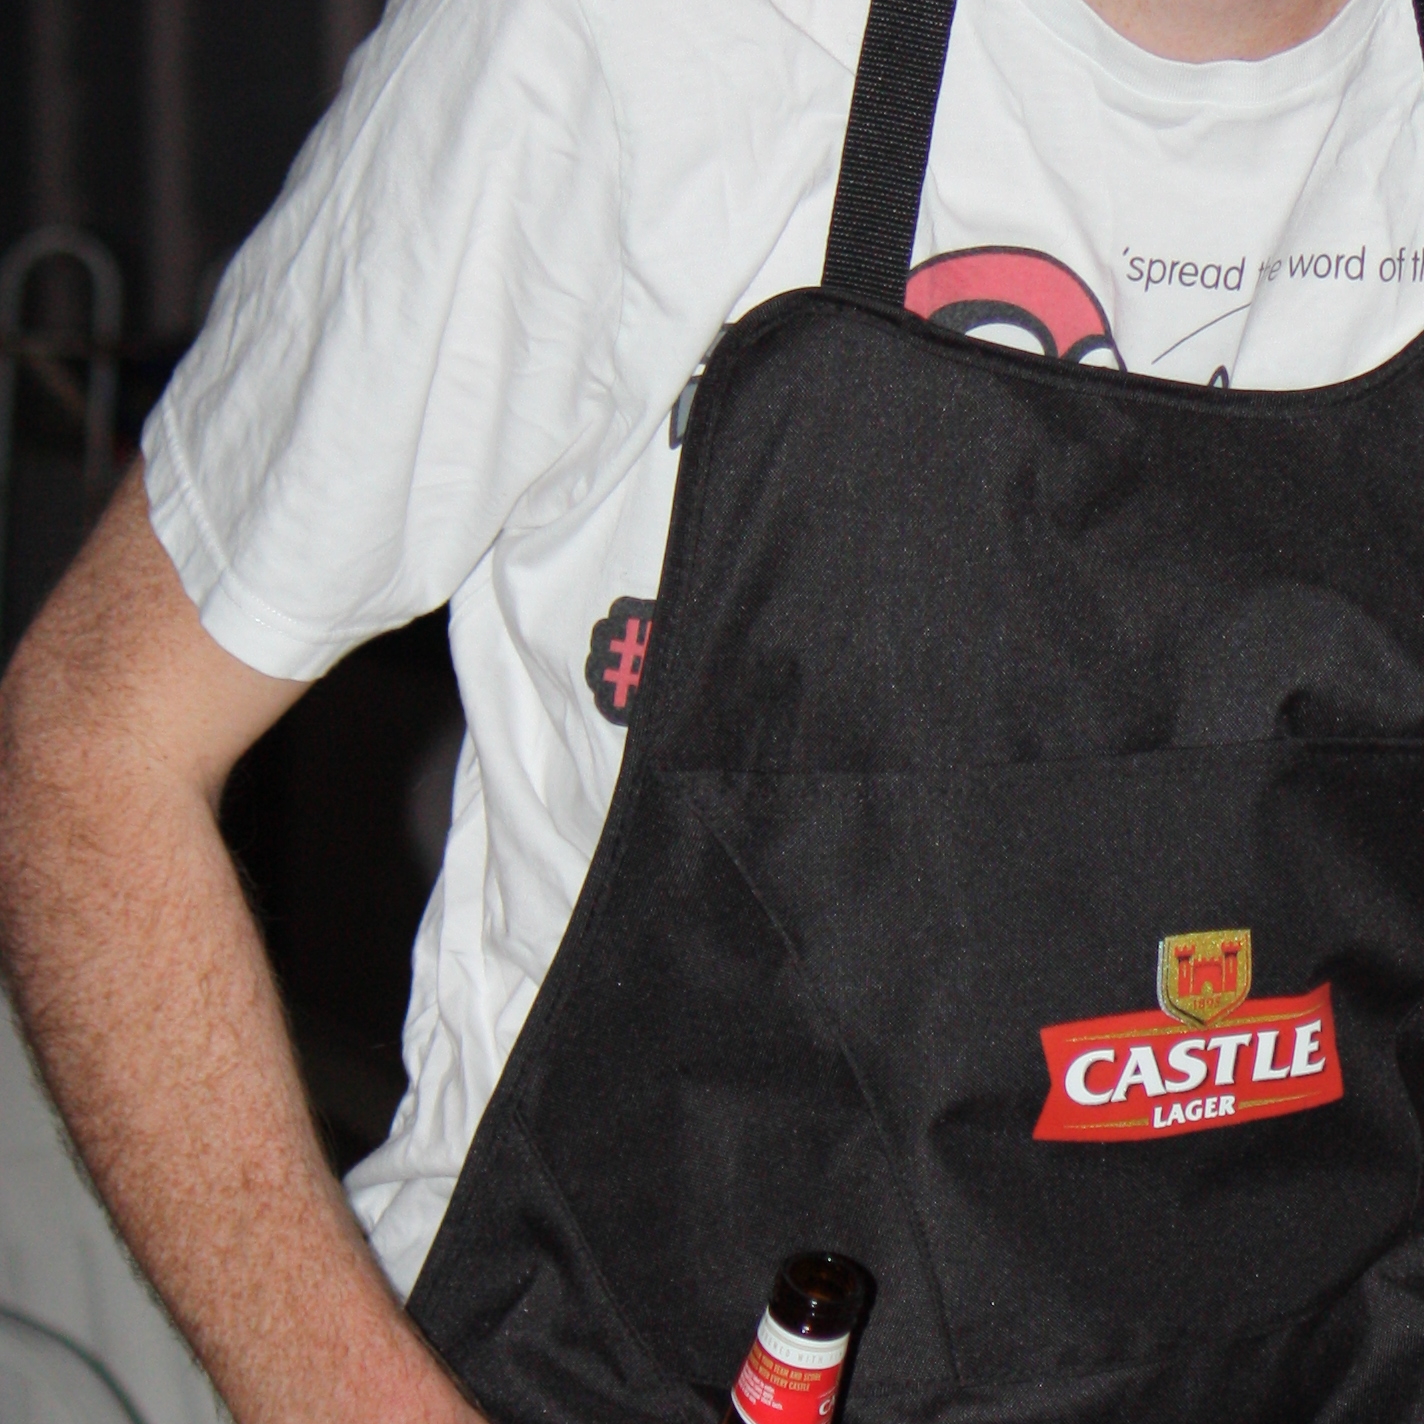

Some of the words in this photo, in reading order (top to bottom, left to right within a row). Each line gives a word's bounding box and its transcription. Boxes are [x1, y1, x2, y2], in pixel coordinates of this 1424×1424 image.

[1288, 246, 1366, 282] word
[1379, 246, 1406, 283] of
[1064, 1019, 1326, 1107] CASTLE
[1152, 1094, 1237, 1128] LAGER
